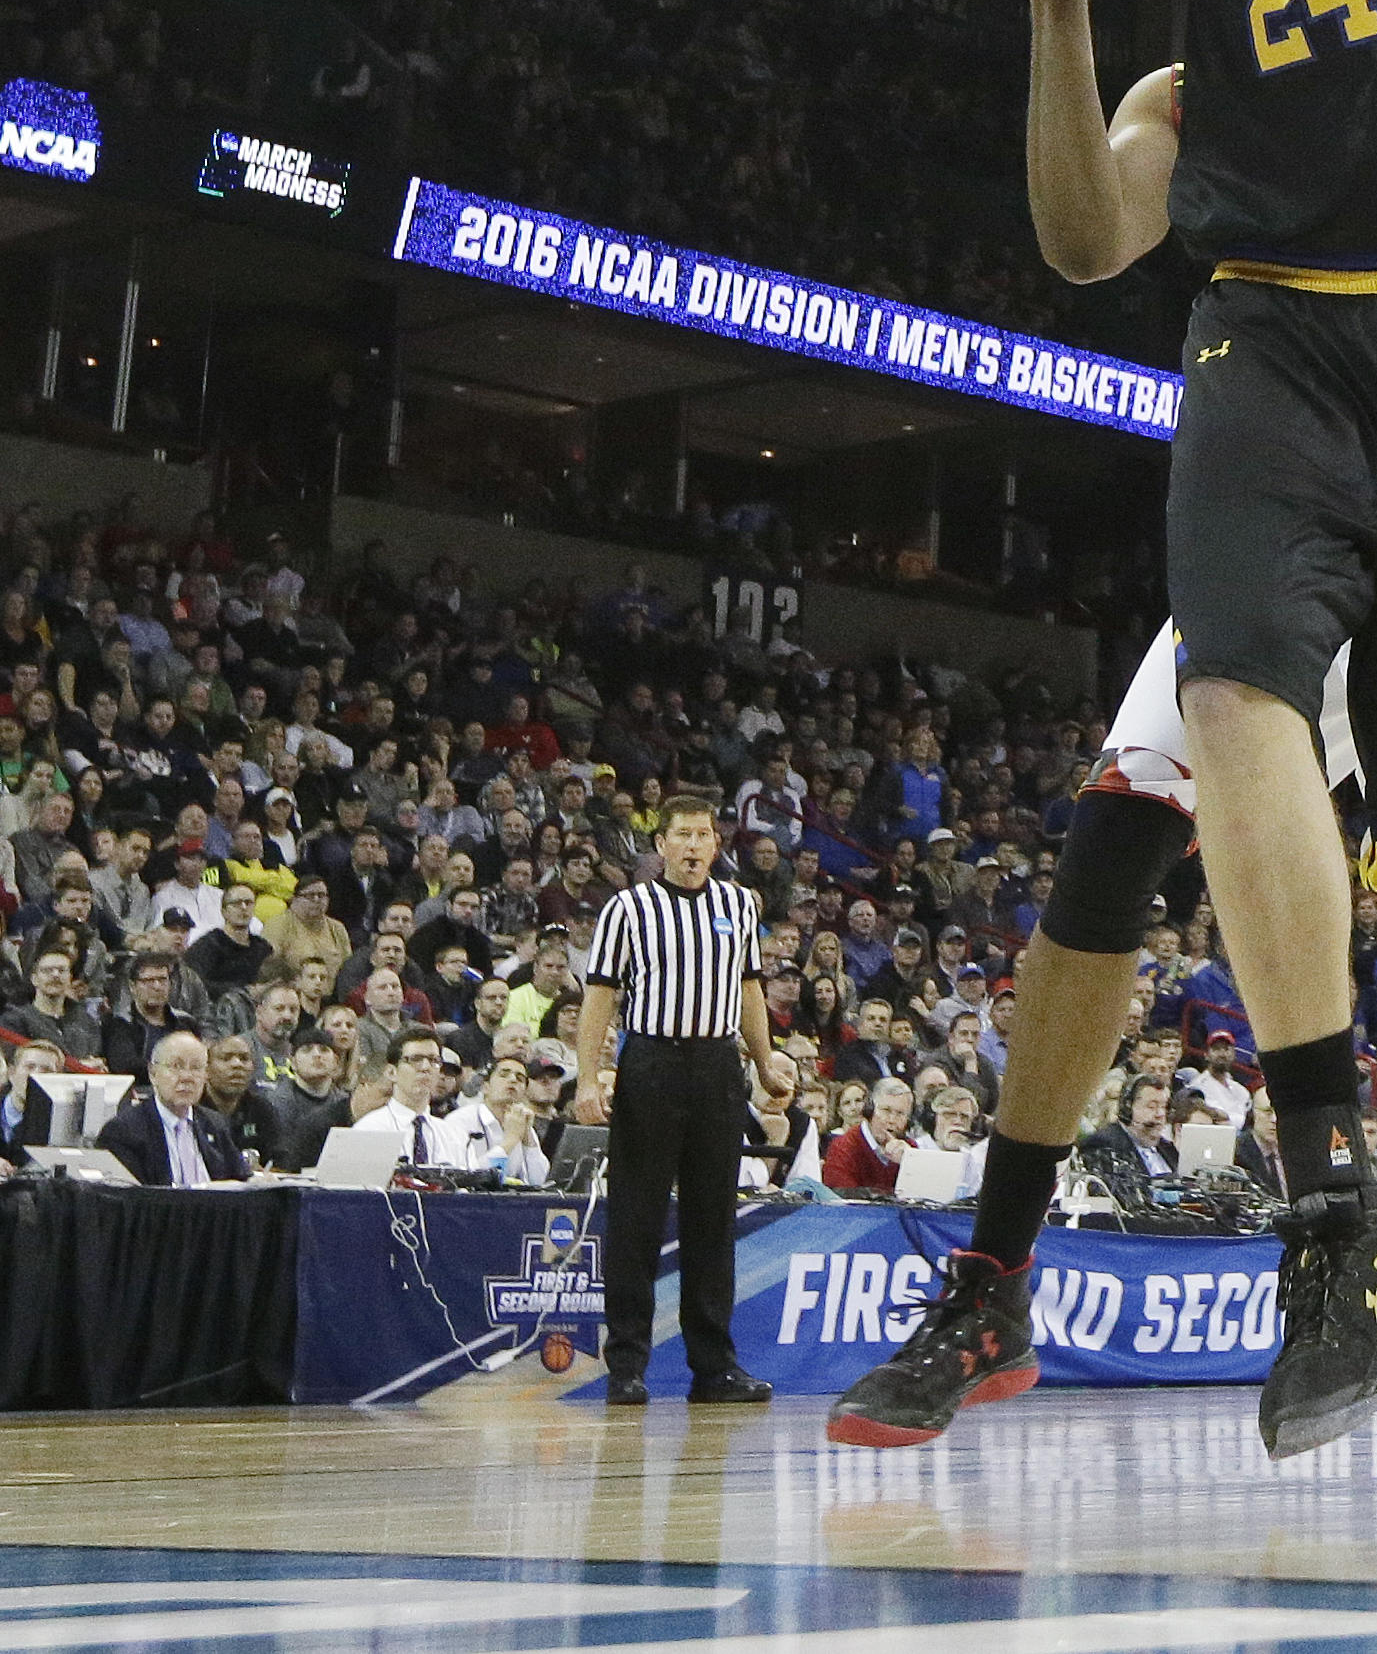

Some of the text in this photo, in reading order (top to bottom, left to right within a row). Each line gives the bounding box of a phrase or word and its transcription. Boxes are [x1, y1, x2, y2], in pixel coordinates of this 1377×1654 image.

[0, 120, 97, 176] NCAA
[237, 136, 312, 176] MARCH
[244, 164, 343, 209] MADNESS
[451, 206, 562, 278] 2016
[569, 233, 678, 309] NCAA
[687, 263, 859, 352] DIVISION
[887, 315, 1001, 385] MEN'S
[498, 1292, 605, 1313] SECOND ROUN
[533, 1272, 576, 1292] FIRST
[778, 1252, 950, 1345] FIRS
[1029, 1267, 1281, 1353] ND SECO
